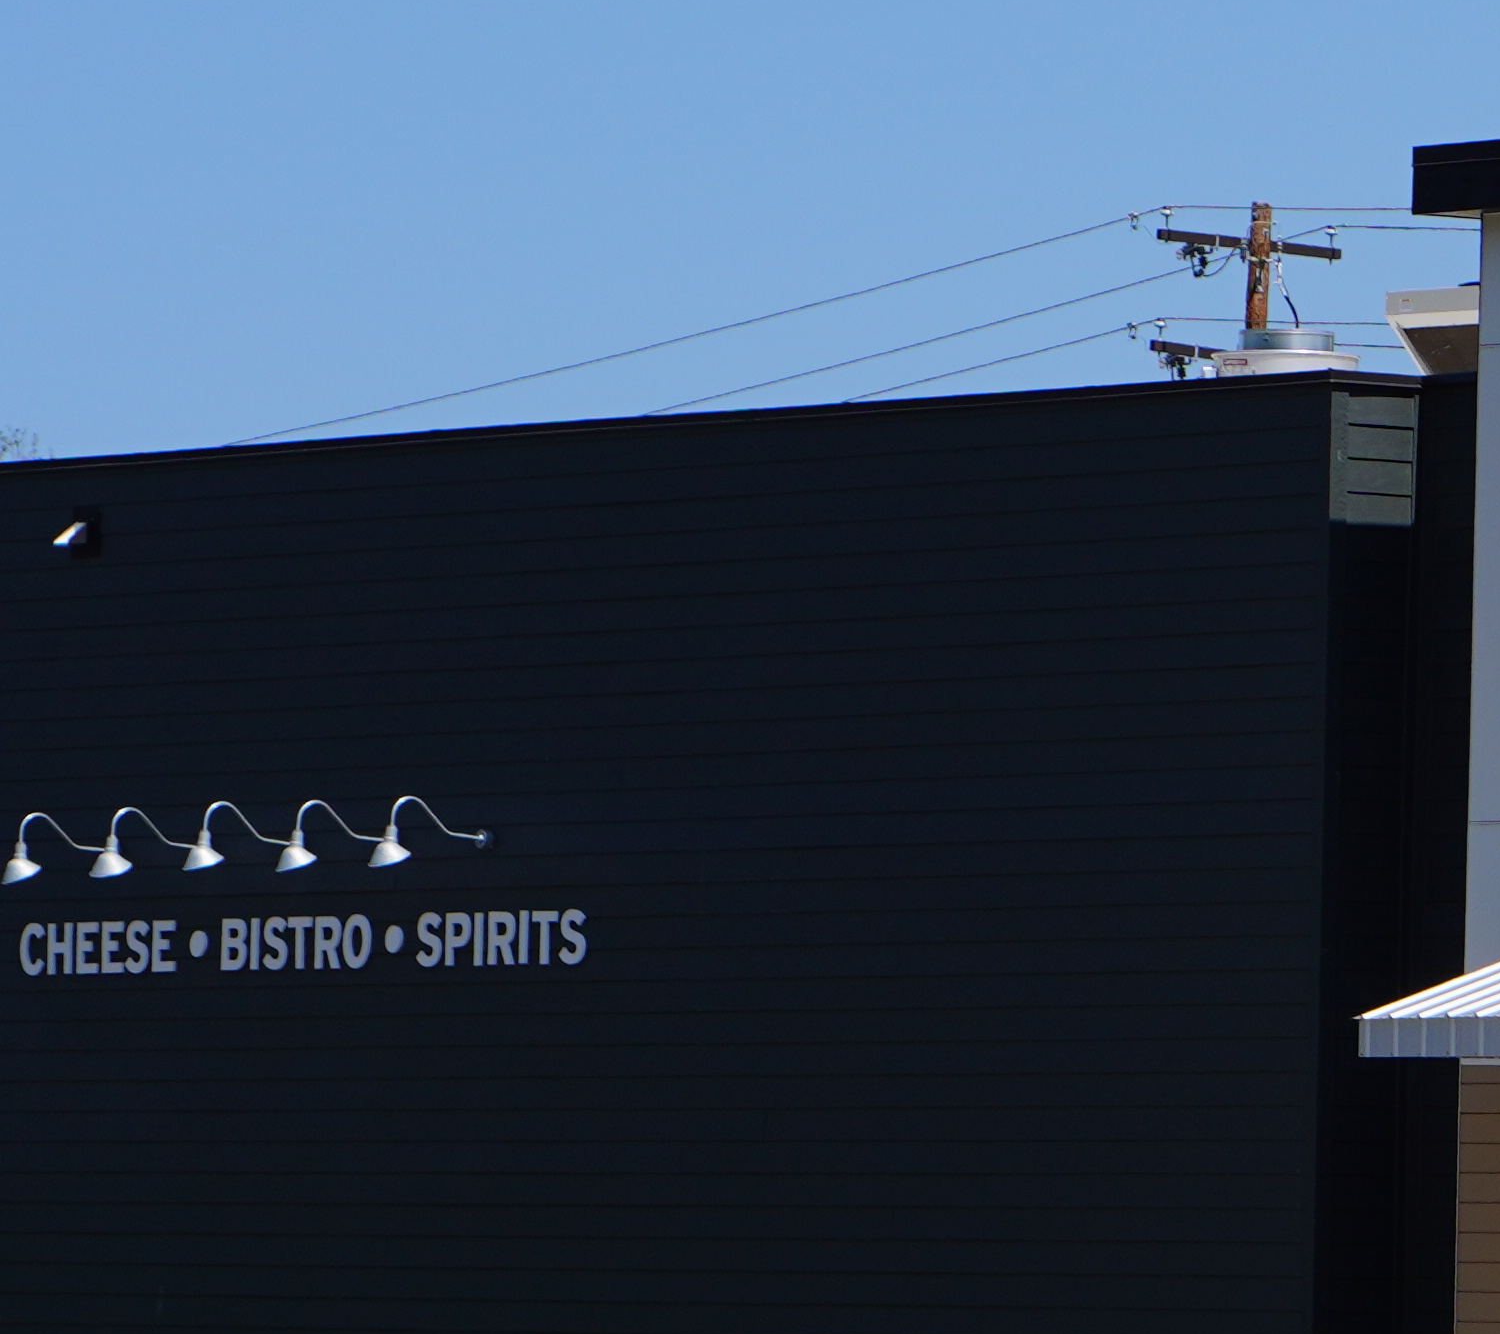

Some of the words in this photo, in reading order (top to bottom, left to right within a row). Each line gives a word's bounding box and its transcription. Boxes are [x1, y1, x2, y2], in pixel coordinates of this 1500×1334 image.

[19, 920, 177, 976] CHEESE
[219, 914, 372, 971] BISTRO
[415, 908, 587, 967] SPIRITS
